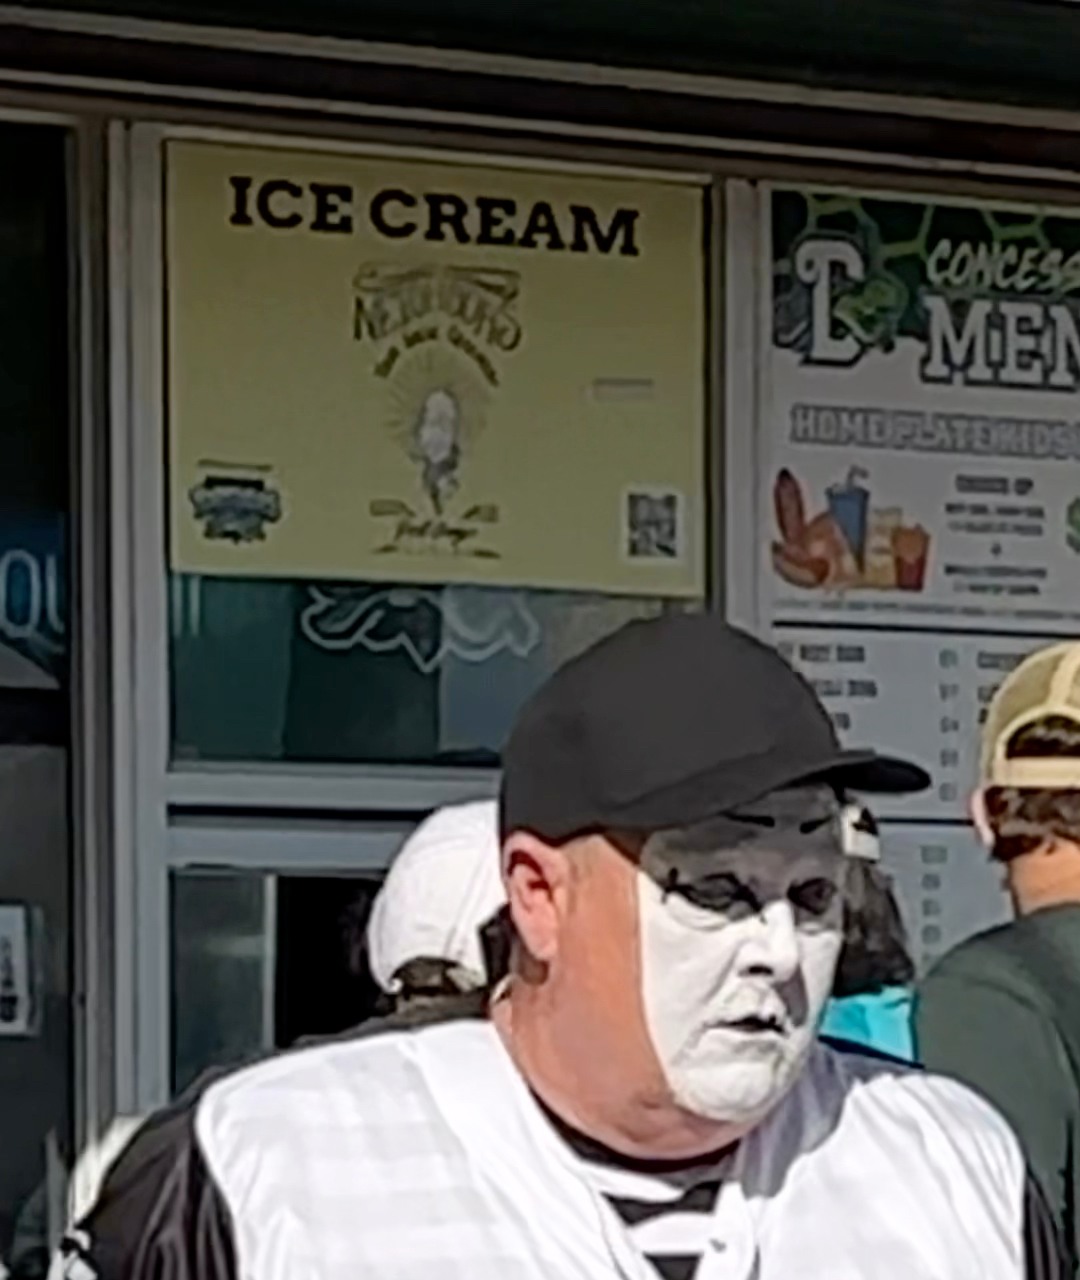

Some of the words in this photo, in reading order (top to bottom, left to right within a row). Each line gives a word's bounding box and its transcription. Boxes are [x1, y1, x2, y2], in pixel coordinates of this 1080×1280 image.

[228, 176, 352, 234] ICE
[369, 189, 640, 257] CREAM
[791, 405, 887, 449] HOME
